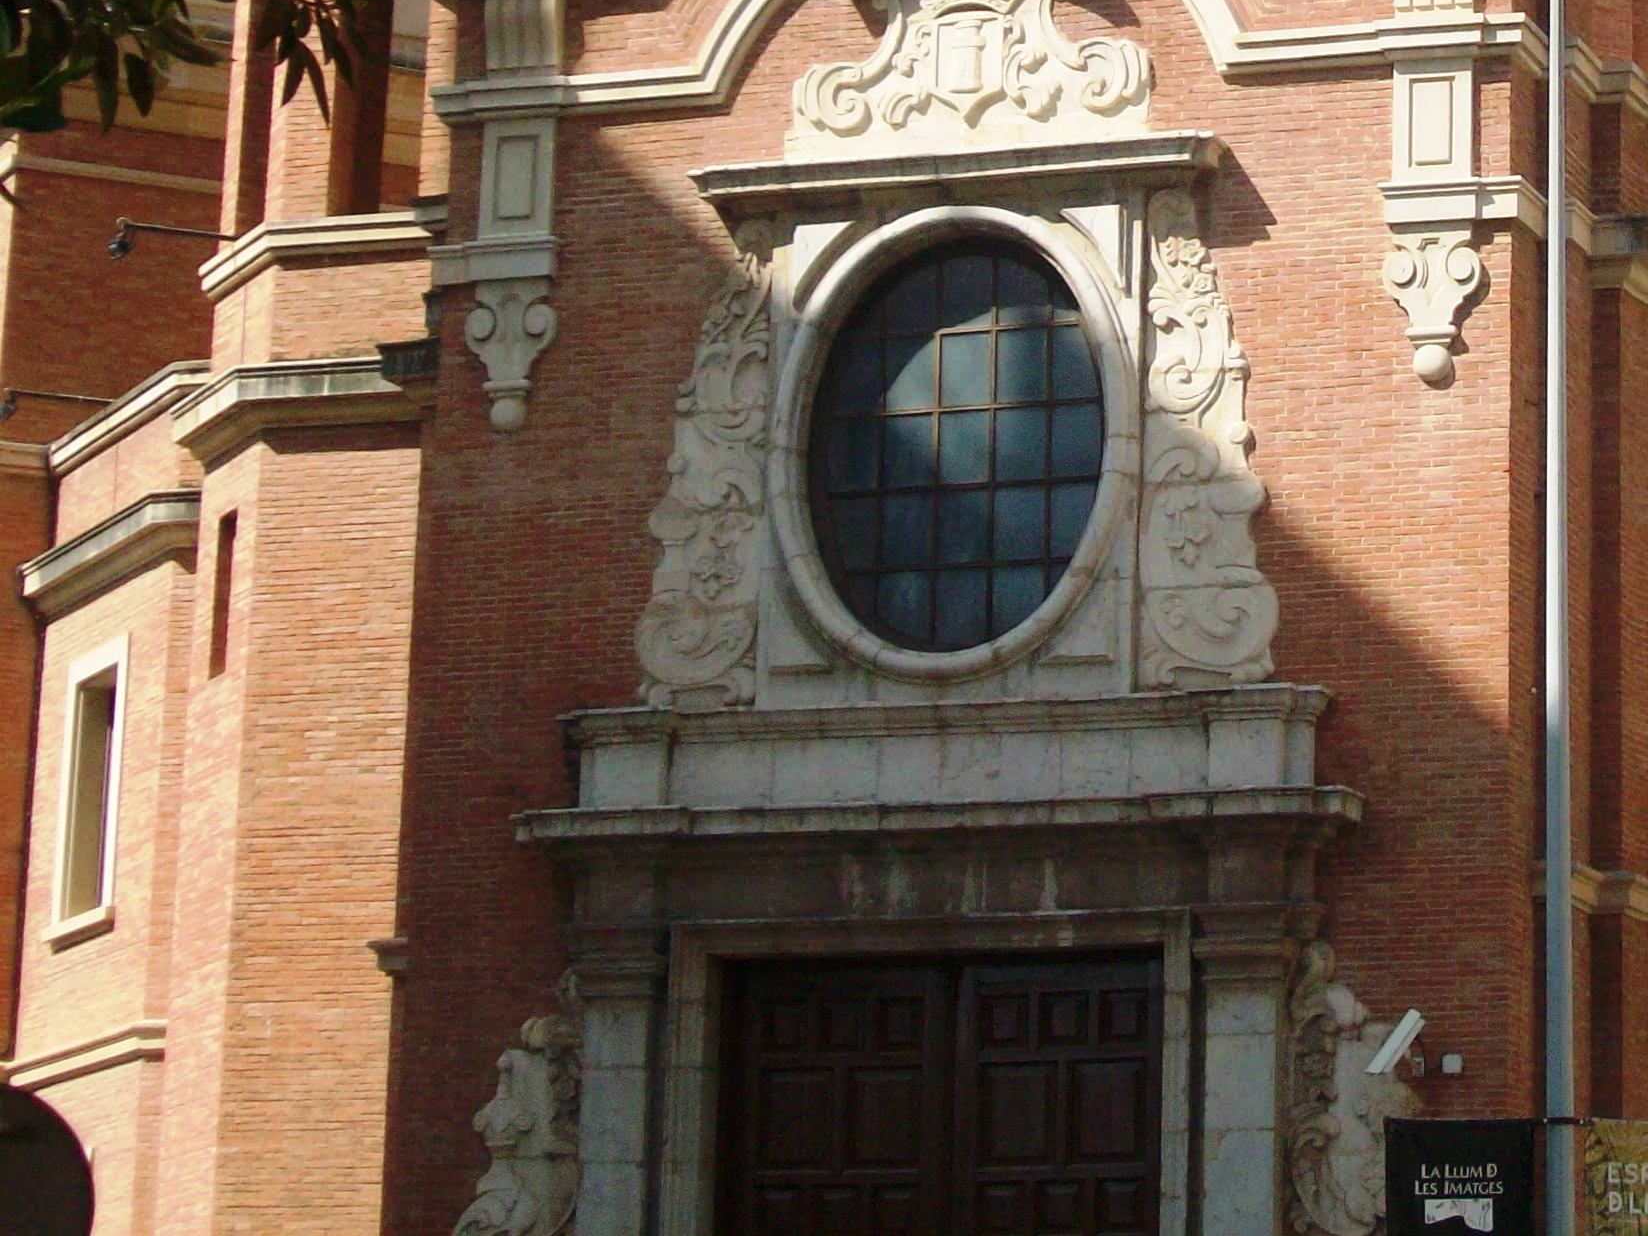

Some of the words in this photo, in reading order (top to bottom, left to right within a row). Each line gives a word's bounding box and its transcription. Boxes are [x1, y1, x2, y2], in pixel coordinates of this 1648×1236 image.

[1421, 1163, 1440, 1179] LA
[1445, 1163, 1483, 1179] LLUM
[1414, 1180, 1438, 1195] LES
[1444, 1180, 1504, 1195] IMATGES
